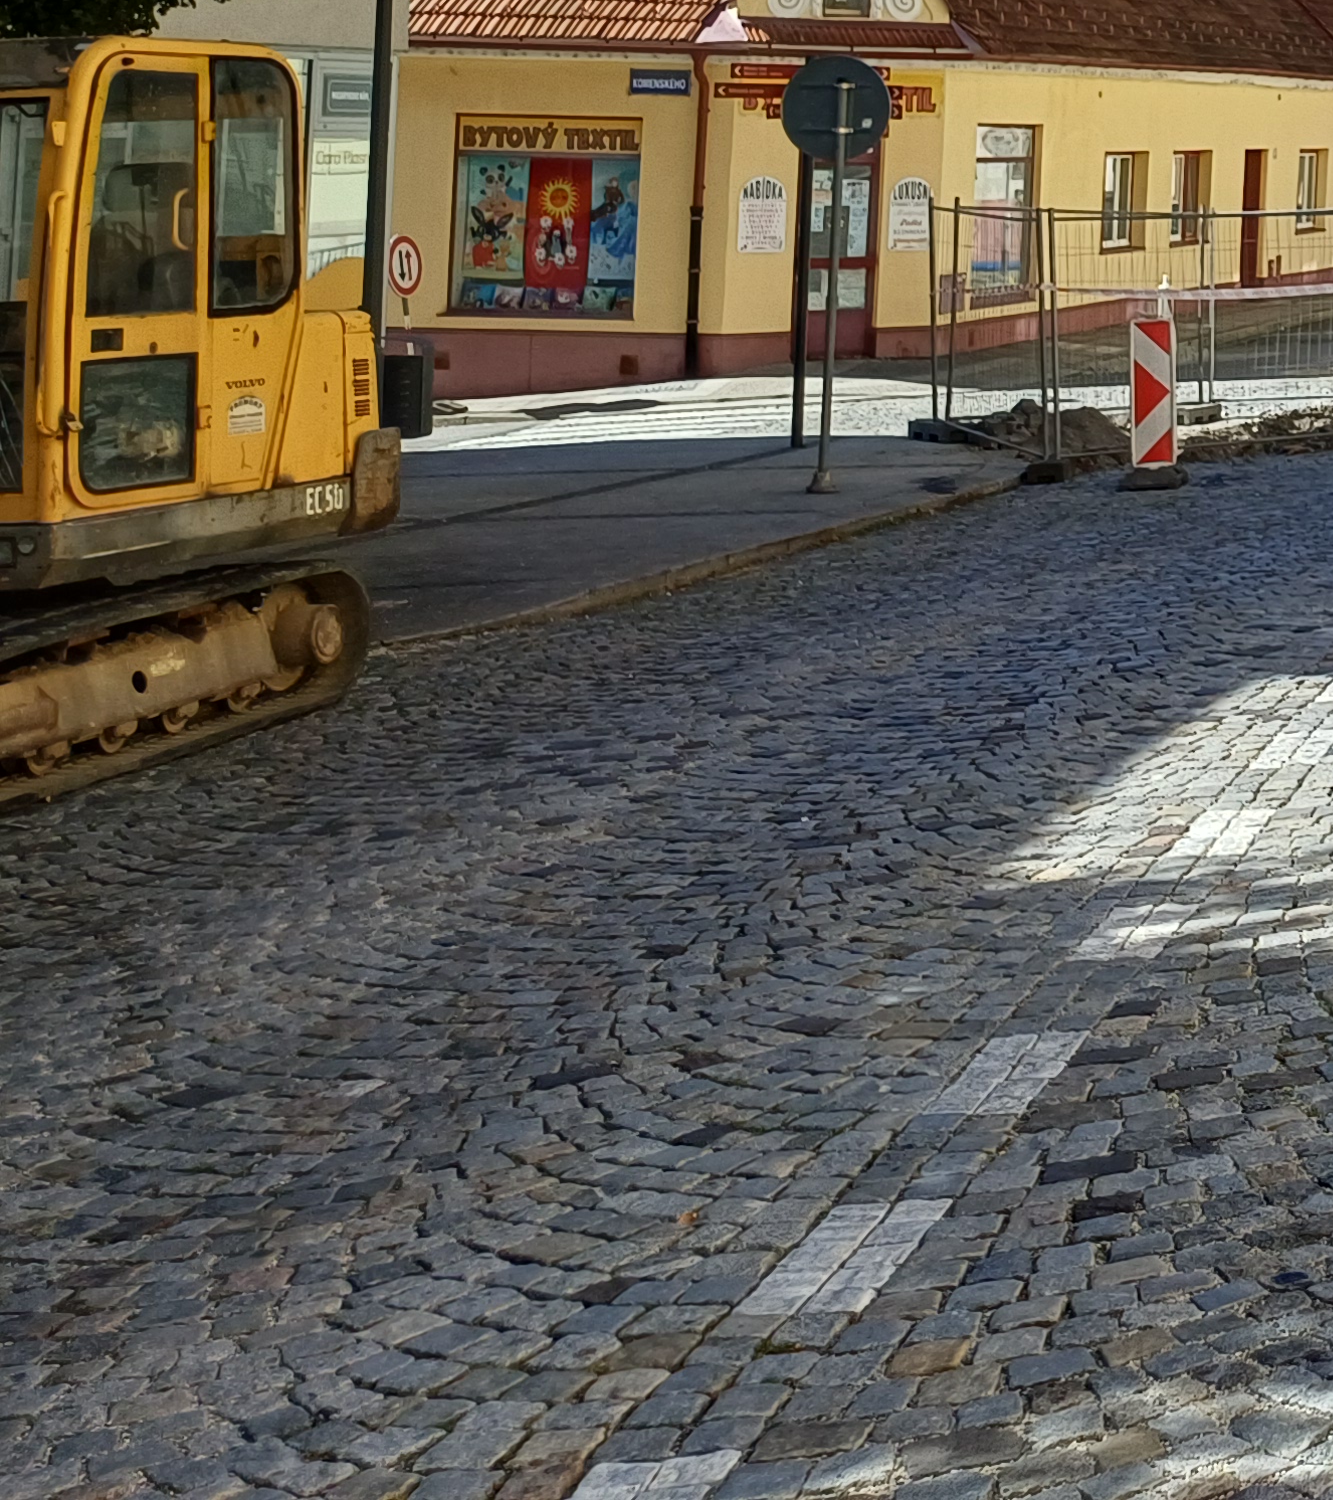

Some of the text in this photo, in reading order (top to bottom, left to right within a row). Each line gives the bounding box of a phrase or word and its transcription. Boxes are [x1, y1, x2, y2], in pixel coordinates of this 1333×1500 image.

[462, 122, 640, 151] BYTOVÝ TEXTIL
[893, 181, 930, 200] LUXUSN
[225, 378, 266, 389] VOLVO
